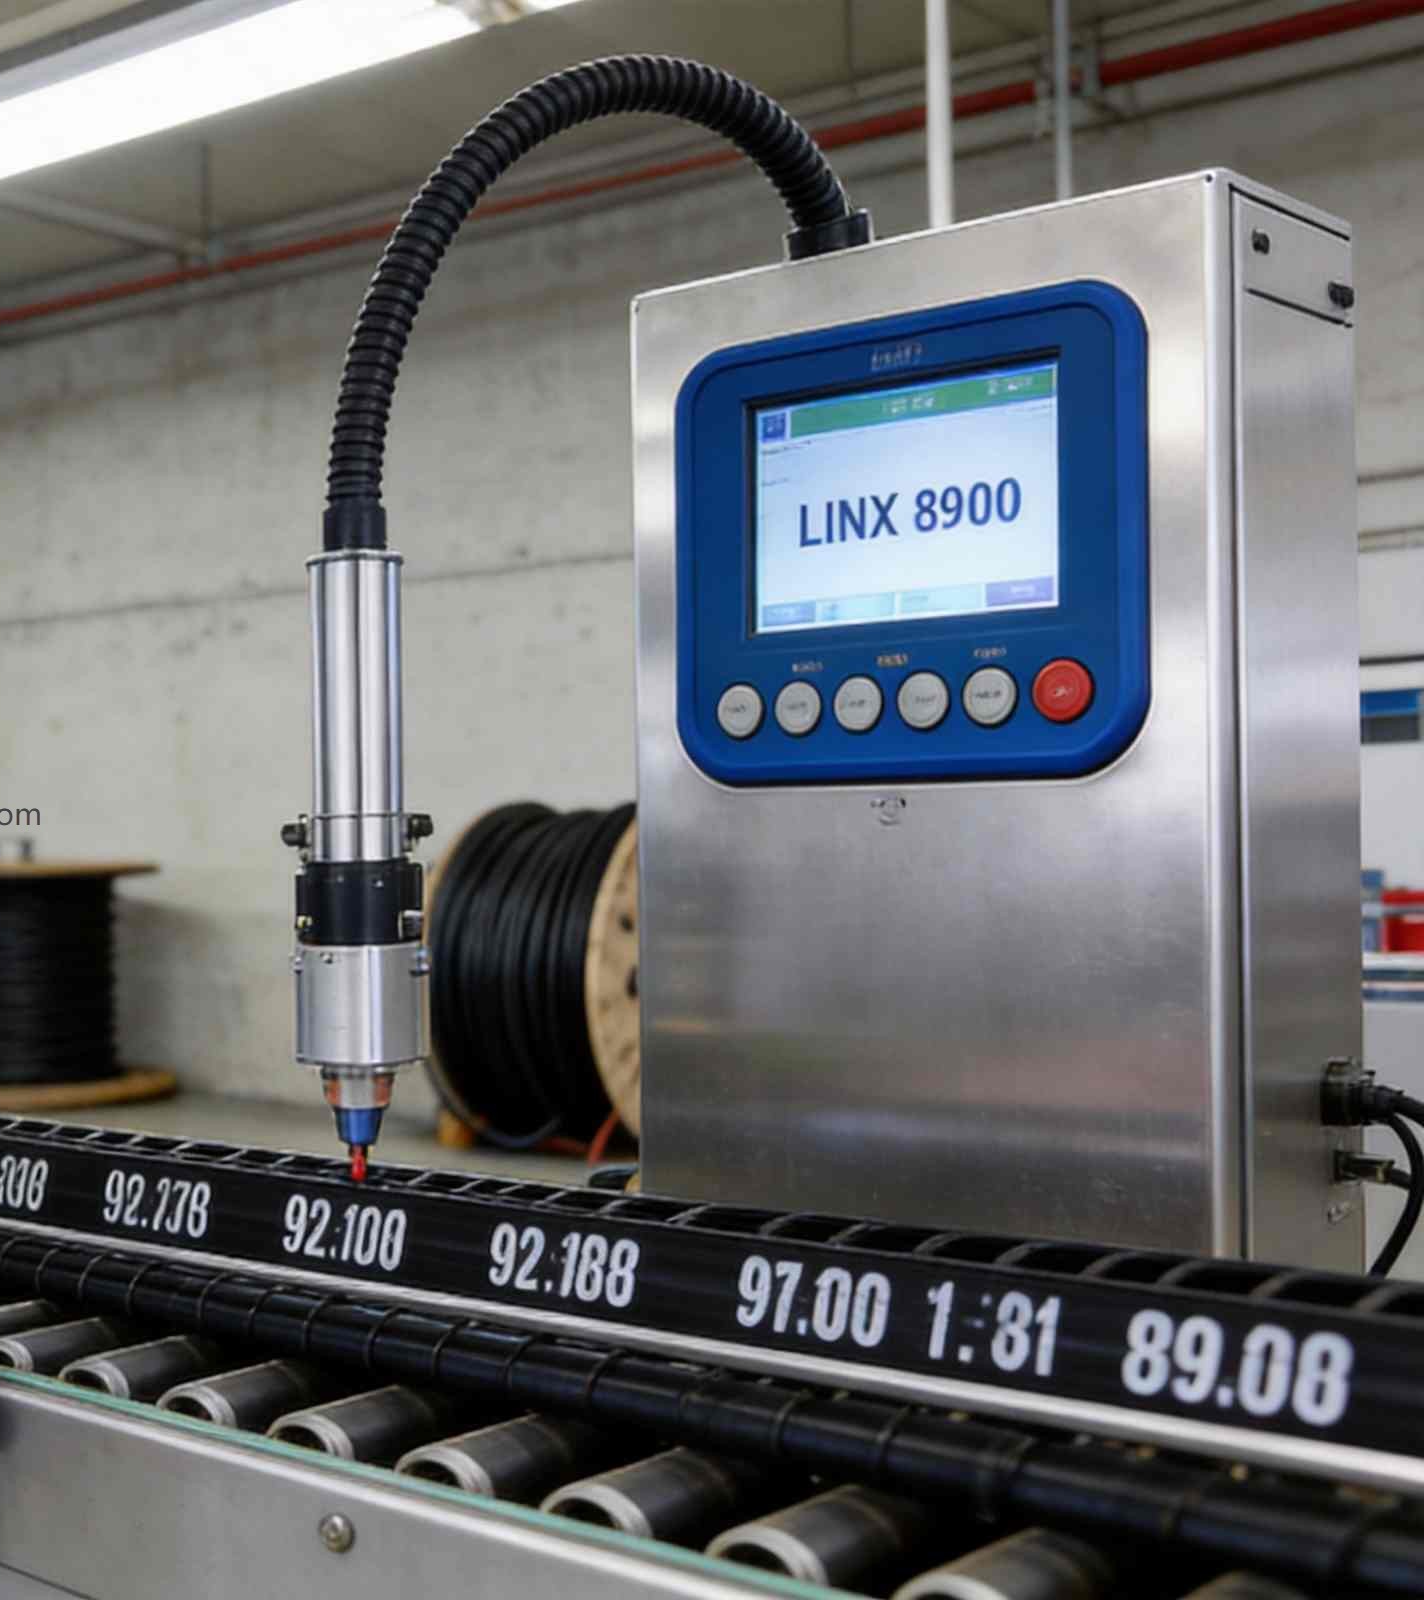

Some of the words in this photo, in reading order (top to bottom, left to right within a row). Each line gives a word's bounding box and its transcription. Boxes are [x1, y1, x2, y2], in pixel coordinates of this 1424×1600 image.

[799, 492, 900, 548] LINX
[913, 477, 1022, 533] 8900
[736, 1254, 891, 1348] 97.00
[1121, 1309, 1355, 1427] 89.08
